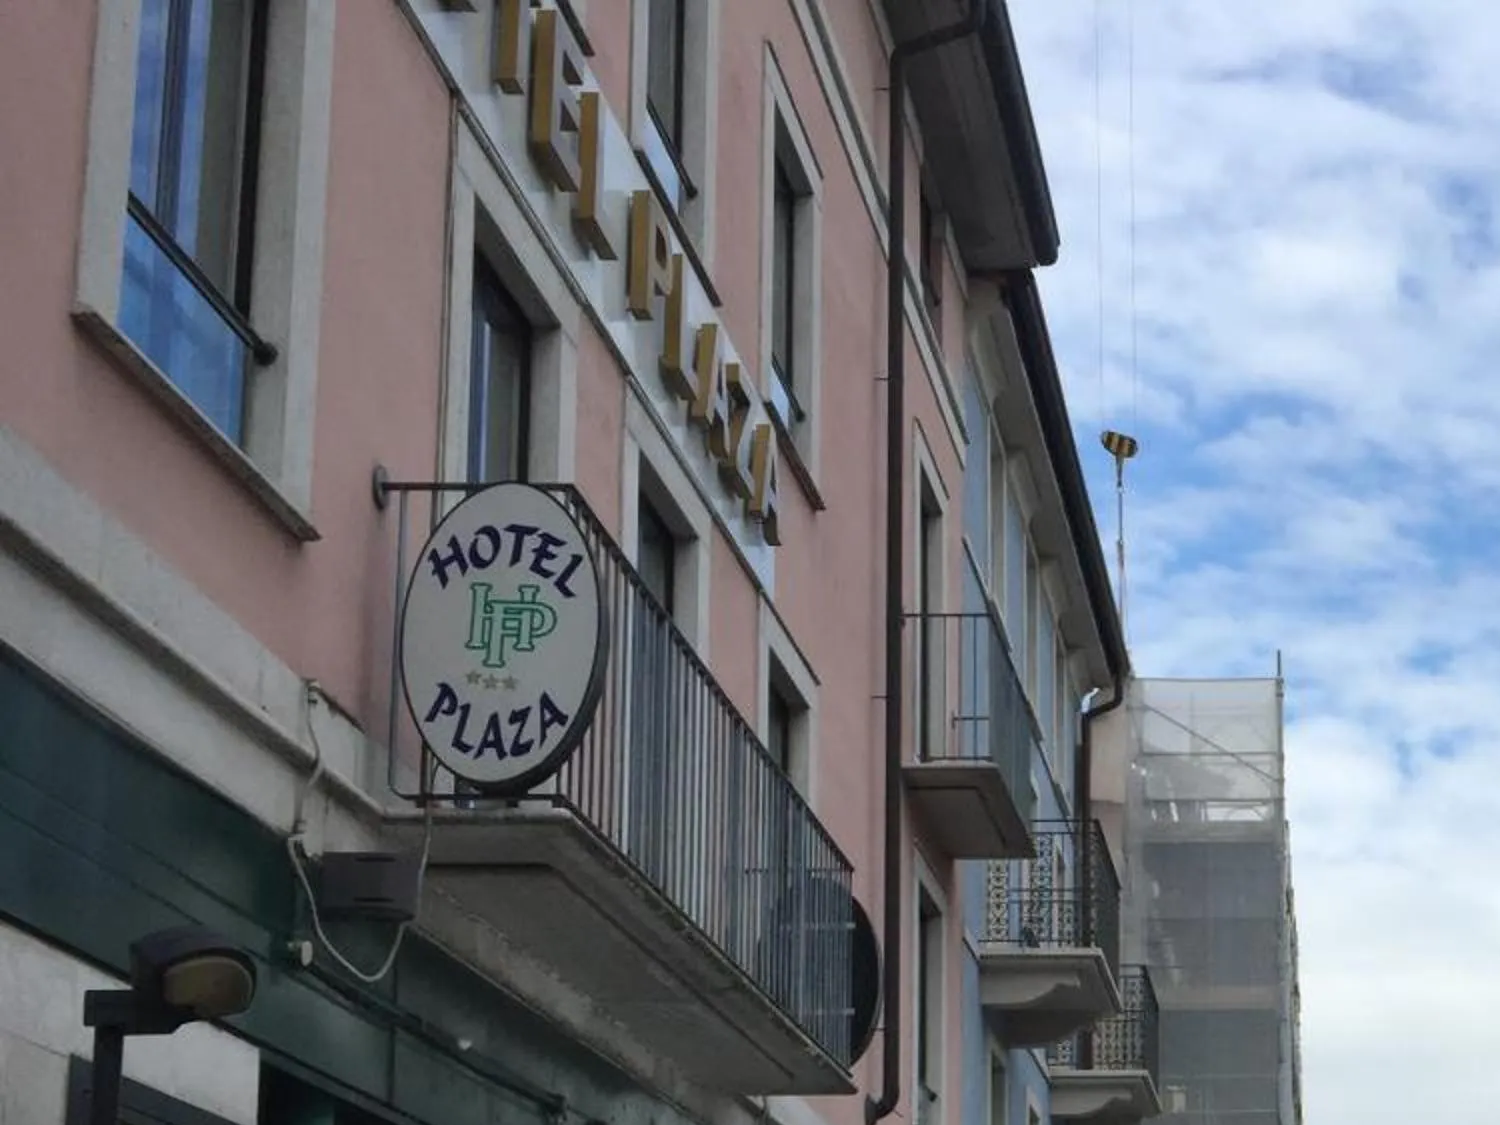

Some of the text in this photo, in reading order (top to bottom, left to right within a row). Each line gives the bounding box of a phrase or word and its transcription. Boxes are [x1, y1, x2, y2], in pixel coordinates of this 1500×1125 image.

[436, 0, 618, 260] TEL
[626, 189, 781, 546] PLAZA
[427, 523, 583, 599] HOTEL
[425, 682, 569, 761] PLAZA
